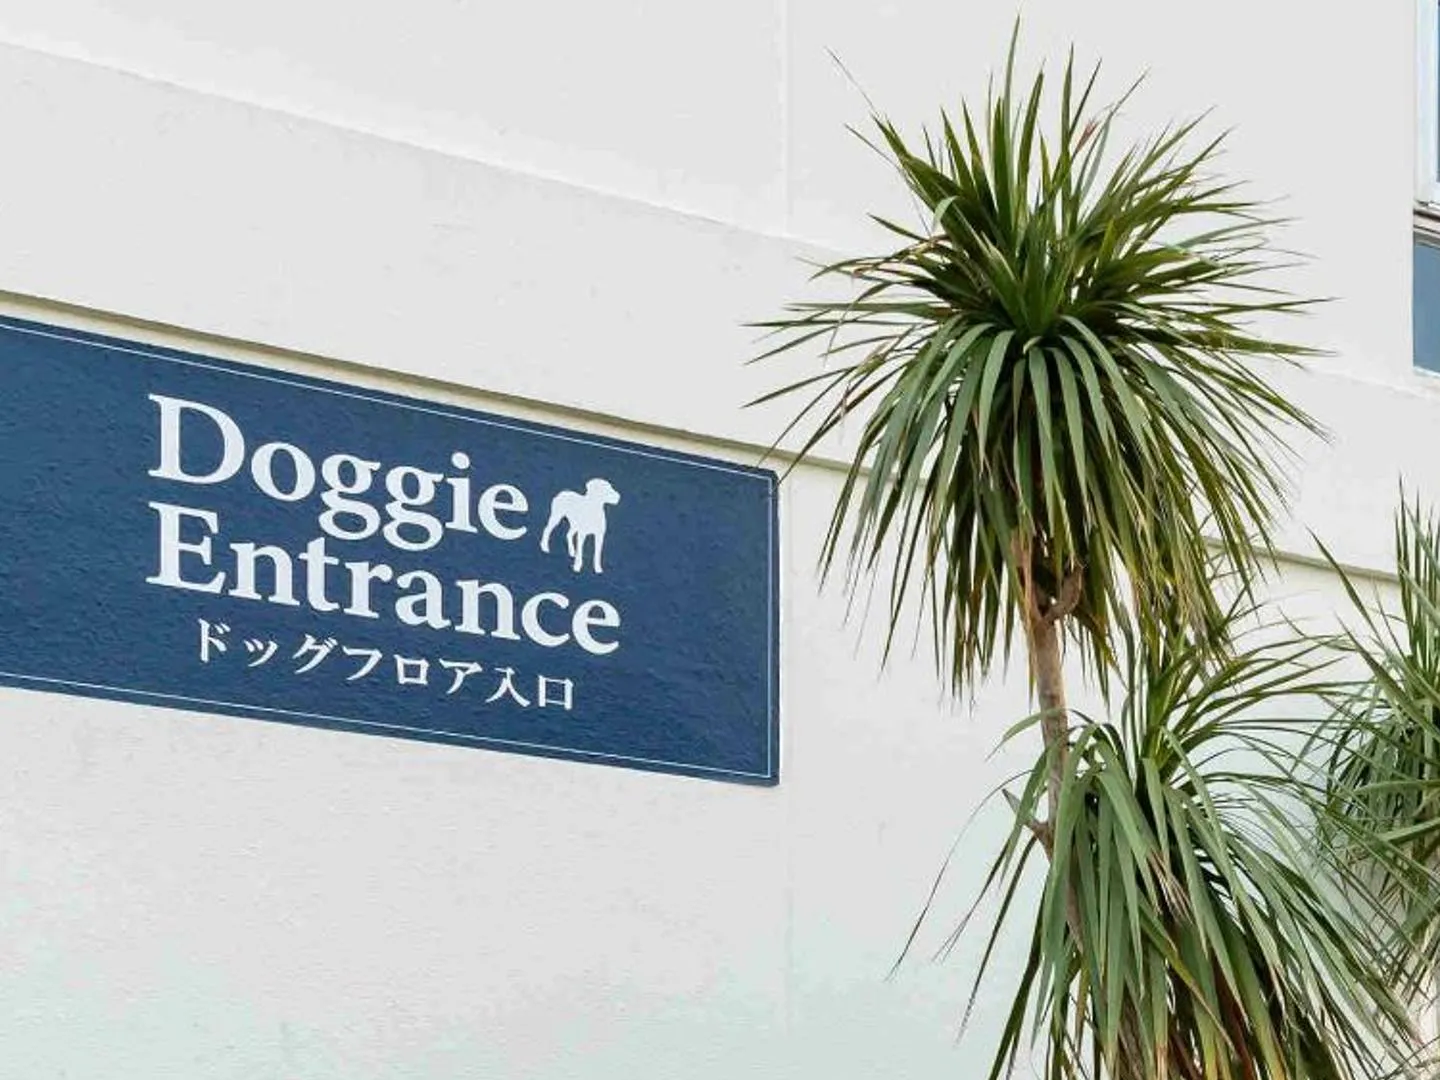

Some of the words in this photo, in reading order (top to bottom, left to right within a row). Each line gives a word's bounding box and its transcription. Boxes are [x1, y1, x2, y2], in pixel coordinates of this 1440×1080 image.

[148, 393, 529, 550] Doggie
[146, 501, 620, 654] Entrance
[198, 618, 574, 710] ドッグフロア入口
